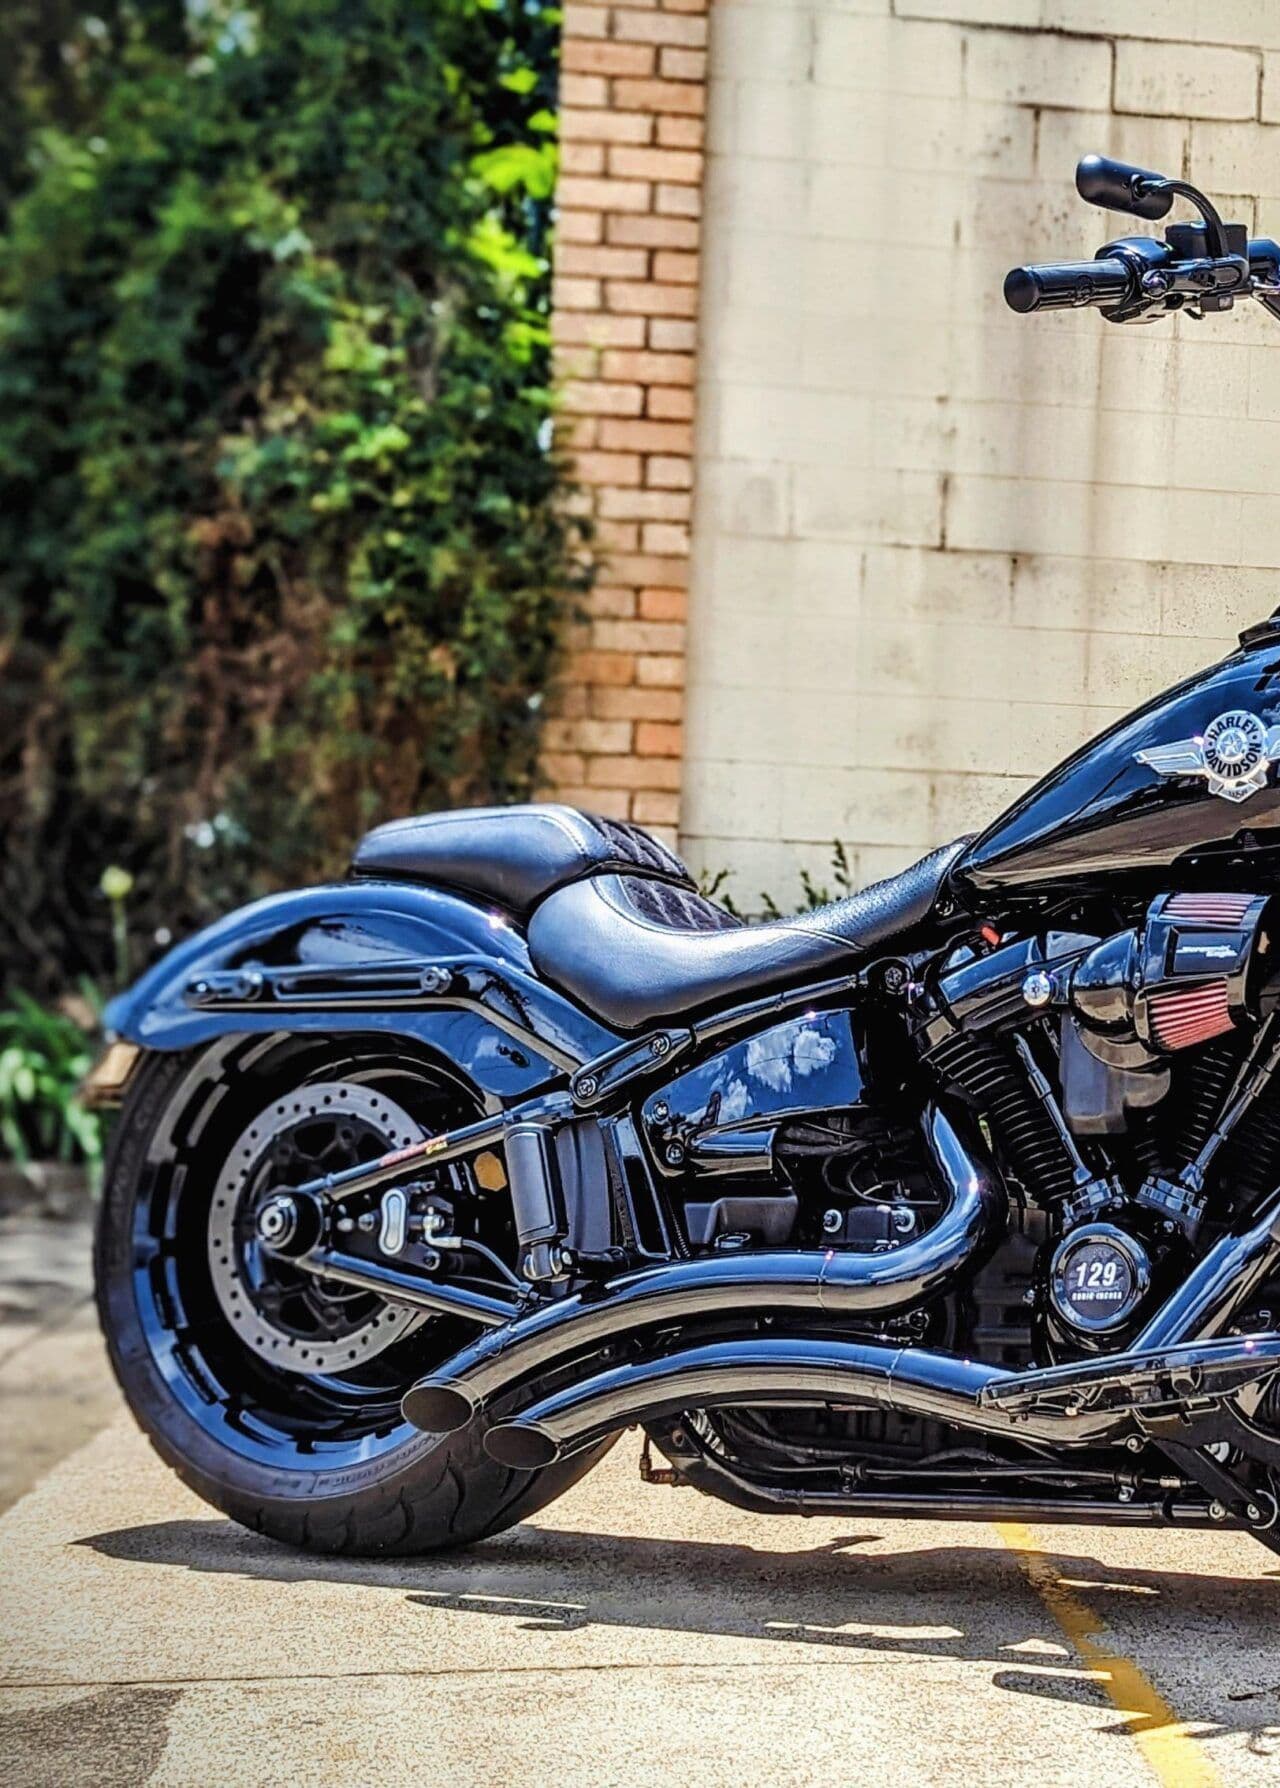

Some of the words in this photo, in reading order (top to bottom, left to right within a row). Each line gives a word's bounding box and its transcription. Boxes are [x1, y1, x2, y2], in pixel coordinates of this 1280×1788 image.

[1208, 716, 1258, 740] HARLEY
[1205, 743, 1262, 777] DAVIDSON
[1076, 1262, 1117, 1287] 129
